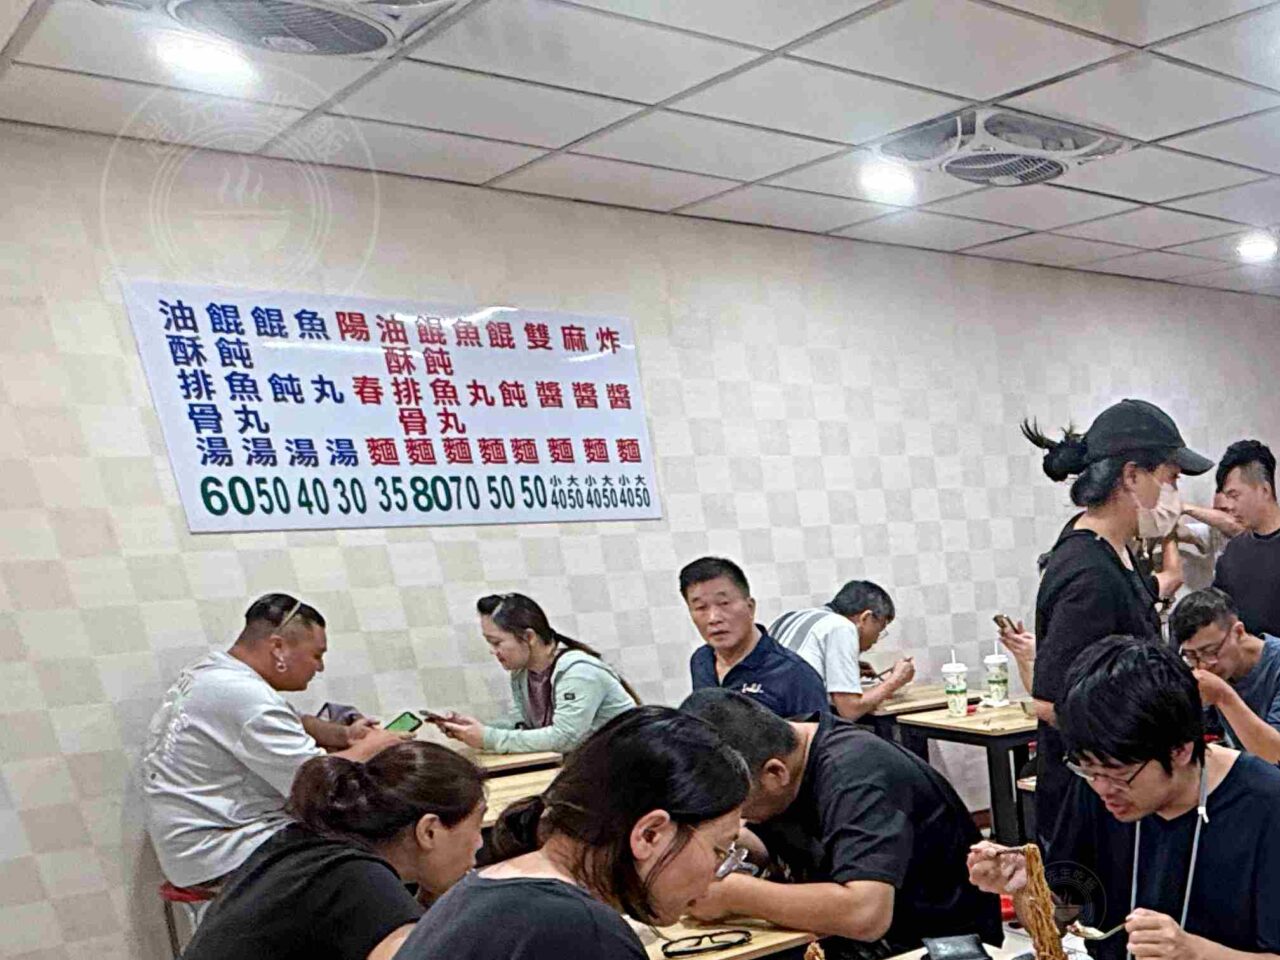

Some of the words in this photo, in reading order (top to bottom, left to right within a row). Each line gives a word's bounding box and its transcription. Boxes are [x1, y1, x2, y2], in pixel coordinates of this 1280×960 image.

[159, 299, 234, 467] 油酥排骨湯
[206, 303, 278, 467] 餛飩魚丸湯
[251, 306, 319, 467] 餛飩湯
[294, 309, 359, 467] 魚丸湯
[336, 311, 400, 466] 陽春麵
[376, 314, 437, 465] 油酥排骨麵
[415, 316, 473, 465] 餛飩魚丸麵
[453, 318, 507, 465] 魚丸麵
[486, 321, 539, 465] 餛飩麵
[524, 323, 575, 464] 雙醬麵
[561, 325, 610, 463] 麻醬麵
[596, 327, 642, 463] 炸醬麵
[200, 475, 256, 516] 60
[255, 476, 291, 514] 50
[298, 478, 329, 515] 40
[333, 478, 367, 514] 30
[374, 476, 408, 512] 35
[410, 476, 450, 512] 80
[450, 476, 480, 510] 70
[487, 475, 514, 509] 50
[520, 475, 547, 508] 50
[550, 475, 562, 487] 小
[567, 475, 579, 487] 大
[585, 475, 597, 487] 小
[602, 475, 613, 487] 大
[619, 475, 630, 487] 小
[634, 475, 646, 486] 大
[551, 488, 567, 509] 40
[568, 488, 584, 509] 50
[586, 488, 601, 508] 40
[602, 488, 618, 508] 50
[619, 488, 634, 508] 40
[635, 488, 650, 507] 50
